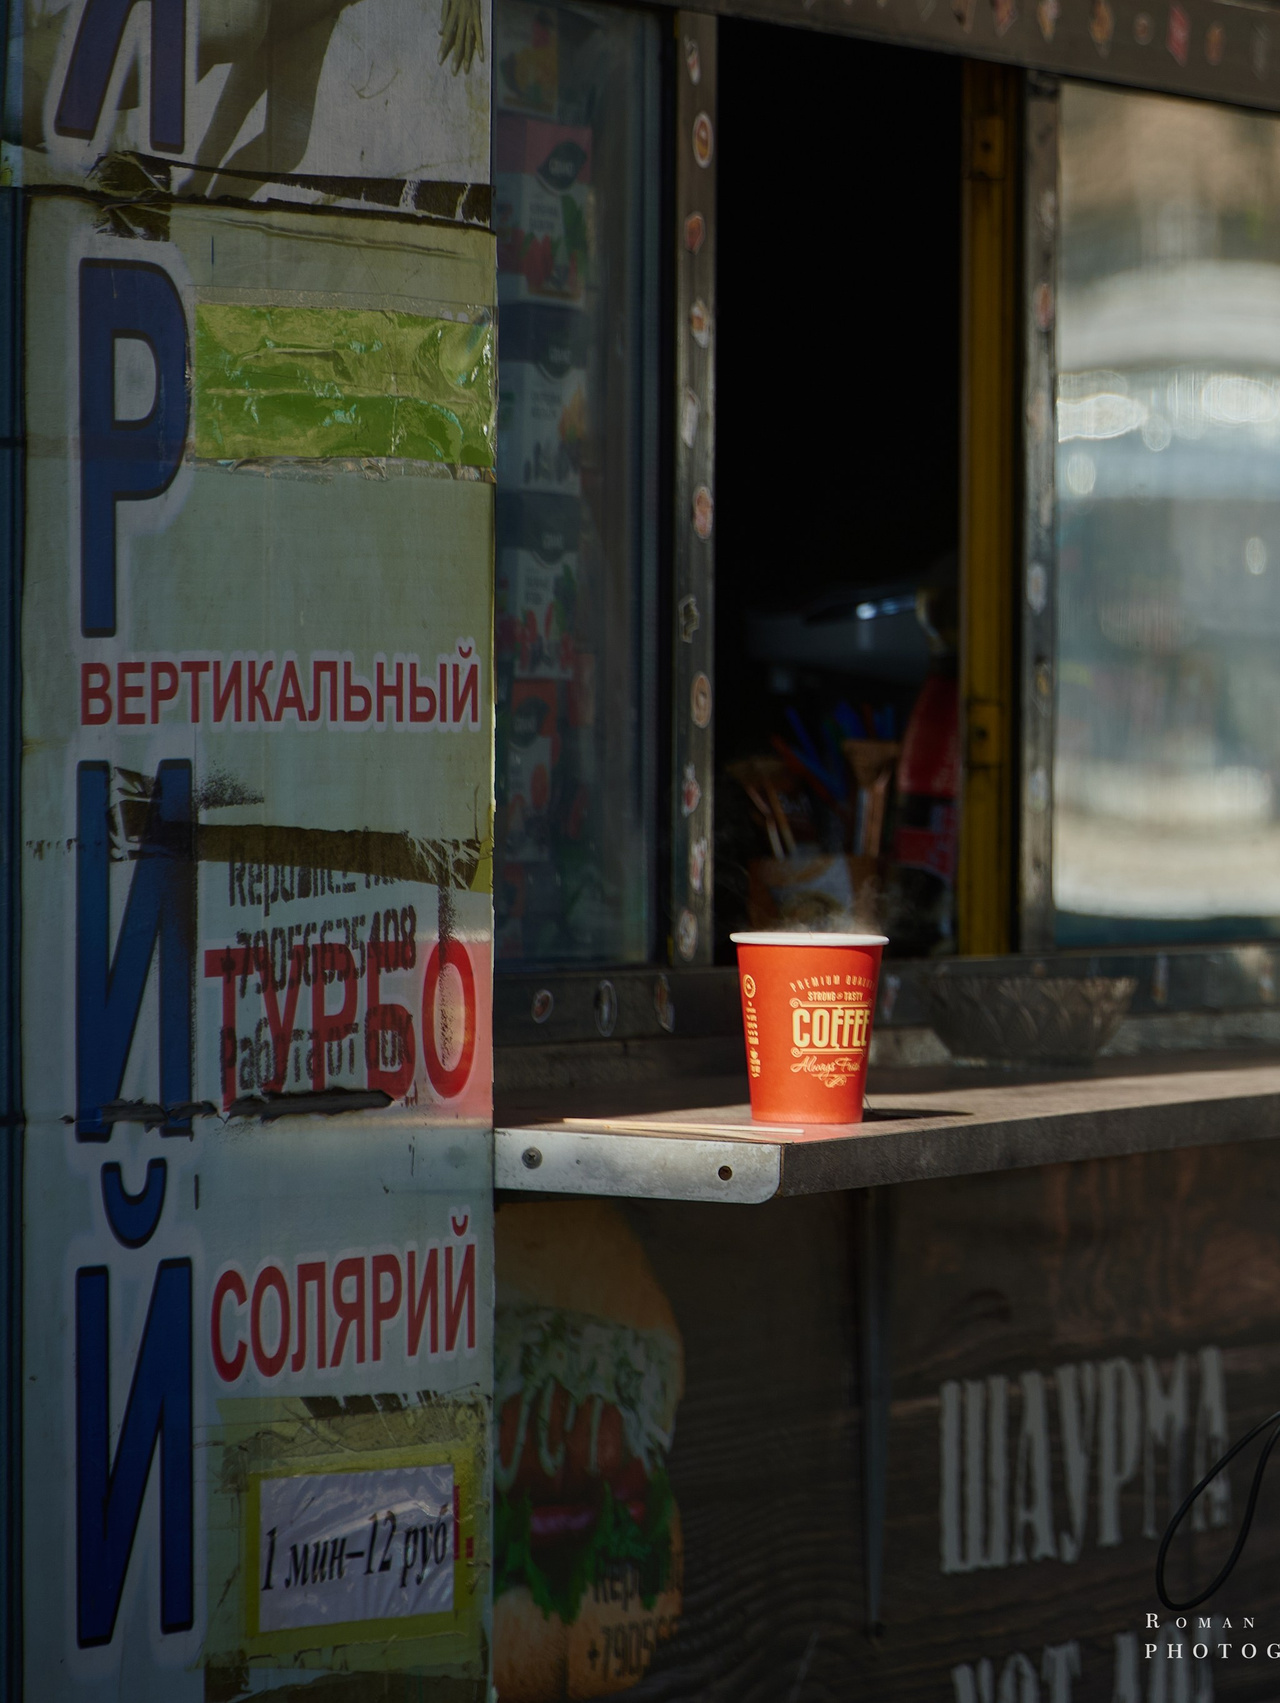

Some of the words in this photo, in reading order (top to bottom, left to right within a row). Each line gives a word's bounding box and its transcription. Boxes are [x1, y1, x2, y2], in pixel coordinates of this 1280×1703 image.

[80, 645, 480, 726] ВЕРТИКАЛЬНЫЙ
[789, 974, 841, 992] PREMIUM
[807, 991, 836, 1002] STRONG
[843, 991, 864, 1002] TASTY
[204, 939, 477, 1111] ТУРБО
[791, 1007, 871, 1048] COFFEE
[791, 1056, 836, 1077] Always
[210, 1214, 477, 1383] СОЛЯРИЙ
[939, 1345, 1233, 1575] ШАУРМА
[261, 1527, 277, 1591] 1
[400, 1503, 450, 1588] руб
